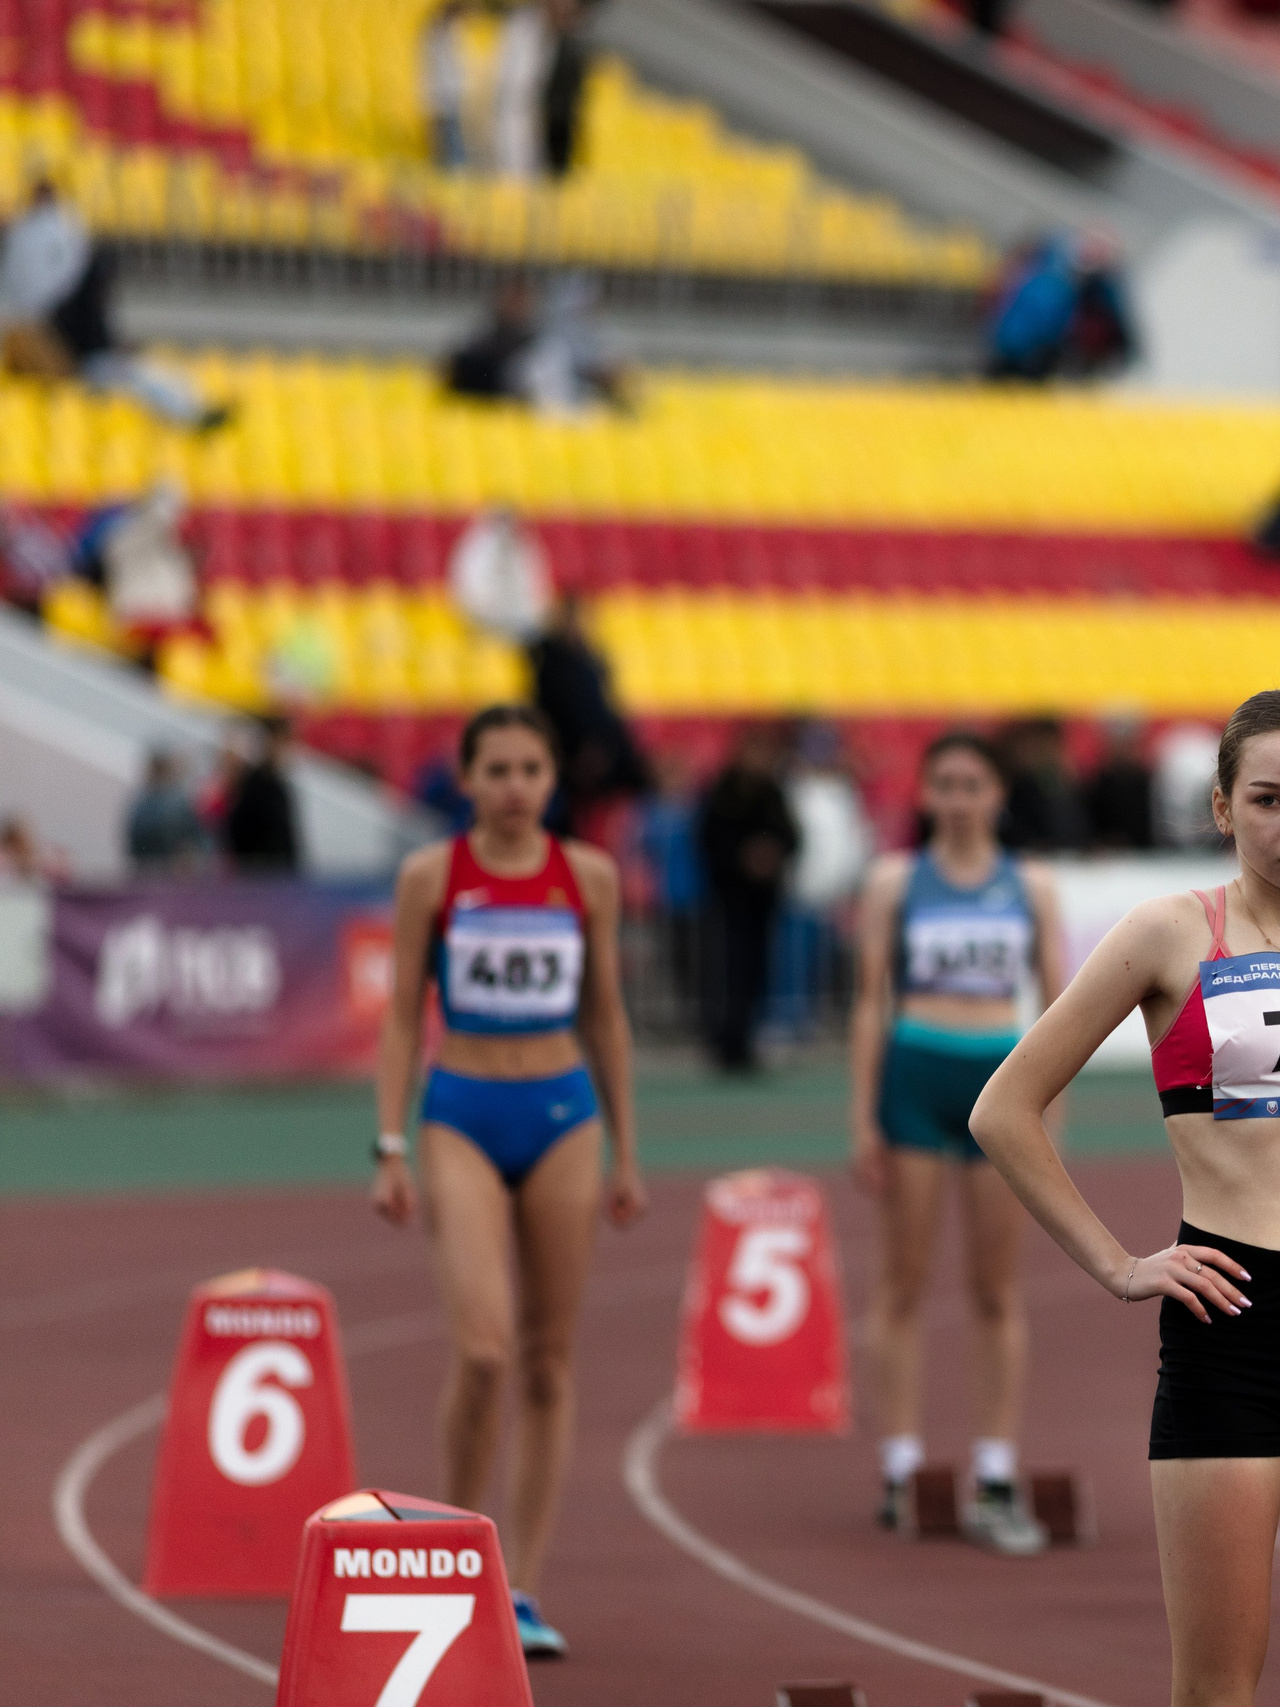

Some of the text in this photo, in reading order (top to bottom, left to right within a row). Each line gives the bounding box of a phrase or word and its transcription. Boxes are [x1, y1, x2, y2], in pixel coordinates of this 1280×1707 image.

[717, 1226, 813, 1347] 5
[207, 1337, 315, 1487] 6
[333, 1547, 483, 1579] MONDO
[340, 1593, 477, 1707] 7
